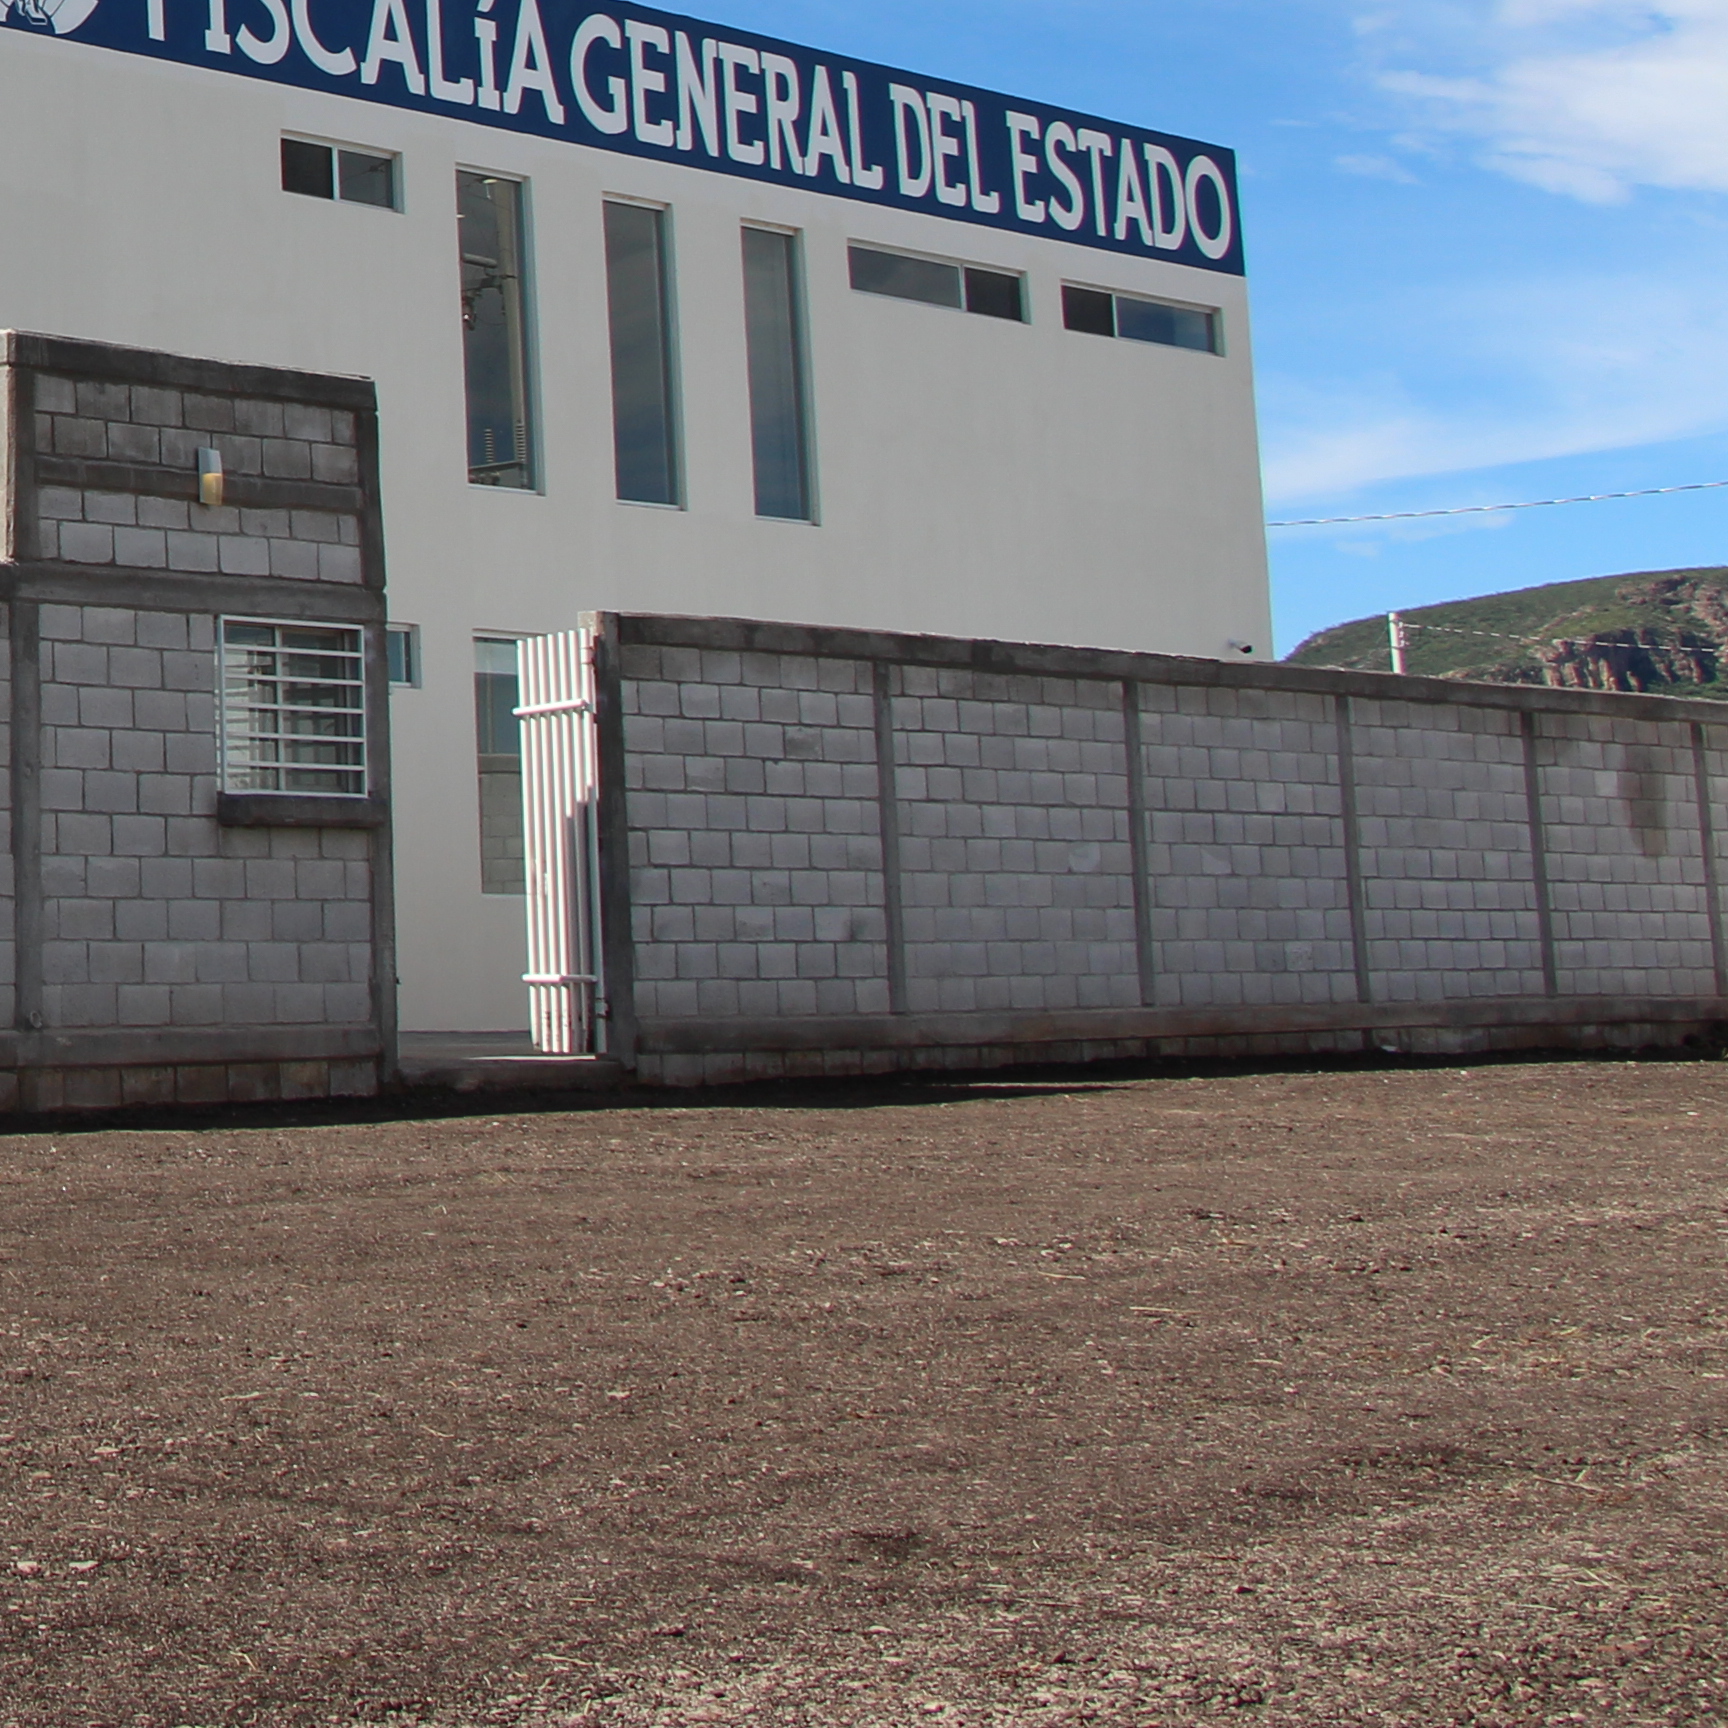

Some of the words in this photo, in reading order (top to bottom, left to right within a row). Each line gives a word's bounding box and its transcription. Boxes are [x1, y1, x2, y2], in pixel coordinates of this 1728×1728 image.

[570, 13, 884, 190] GENERAL
[889, 82, 1000, 214] DEL
[1006, 110, 1232, 260] ESTADO
